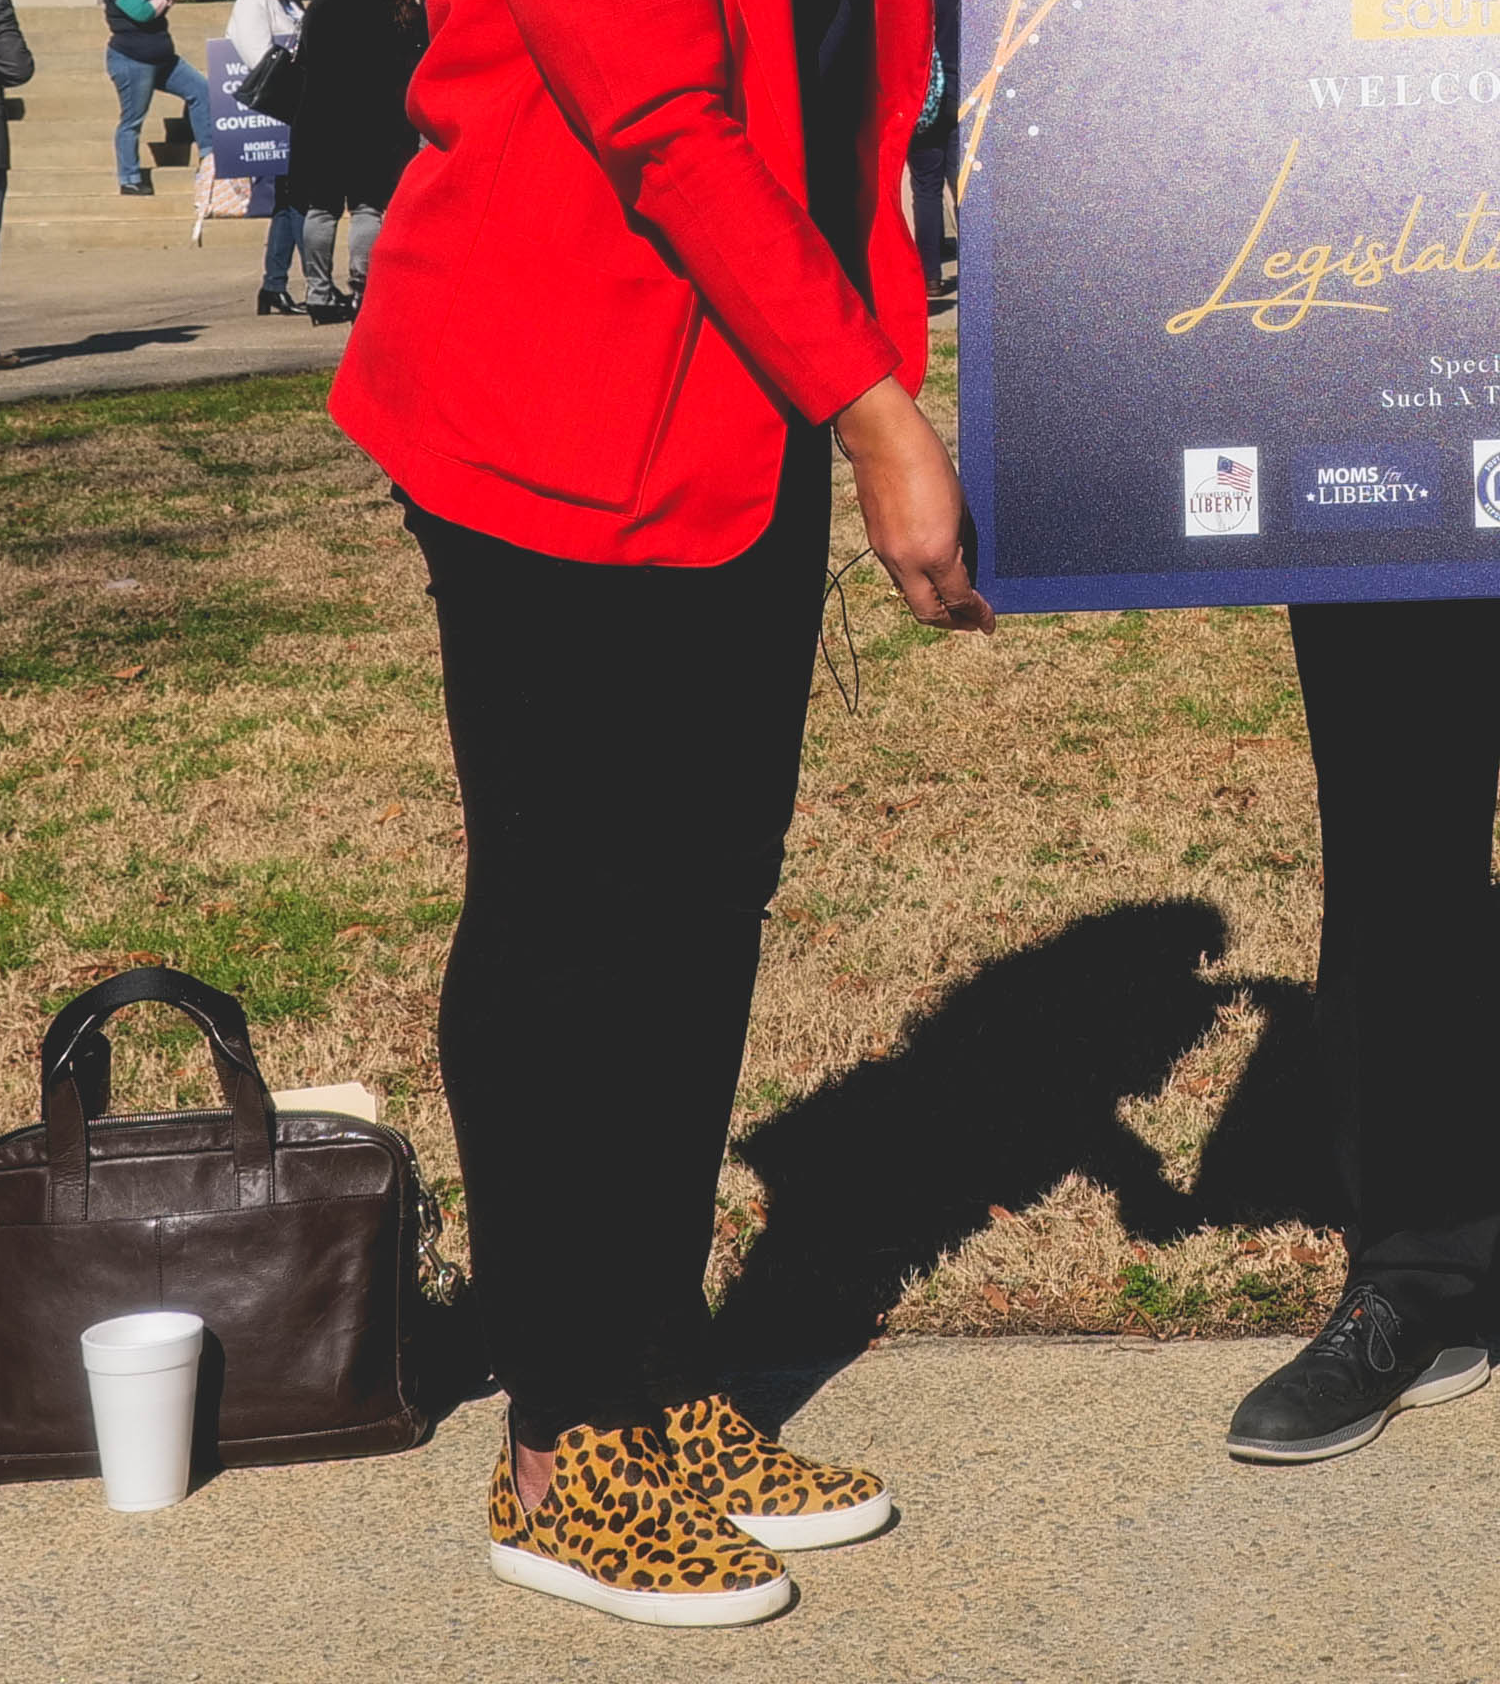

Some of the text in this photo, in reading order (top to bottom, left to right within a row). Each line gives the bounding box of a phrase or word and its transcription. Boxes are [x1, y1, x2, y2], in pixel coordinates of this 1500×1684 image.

[216, 114, 287, 131] GOVERN
[243, 141, 276, 152] MOMS
[244, 149, 289, 162] LIBERT
[1381, 386, 1442, 409] Such
[1453, 386, 1472, 406] A
[1317, 467, 1378, 485] MOMS
[1318, 483, 1419, 505] LIBERTY
[1189, 496, 1253, 514] LIBERTY
